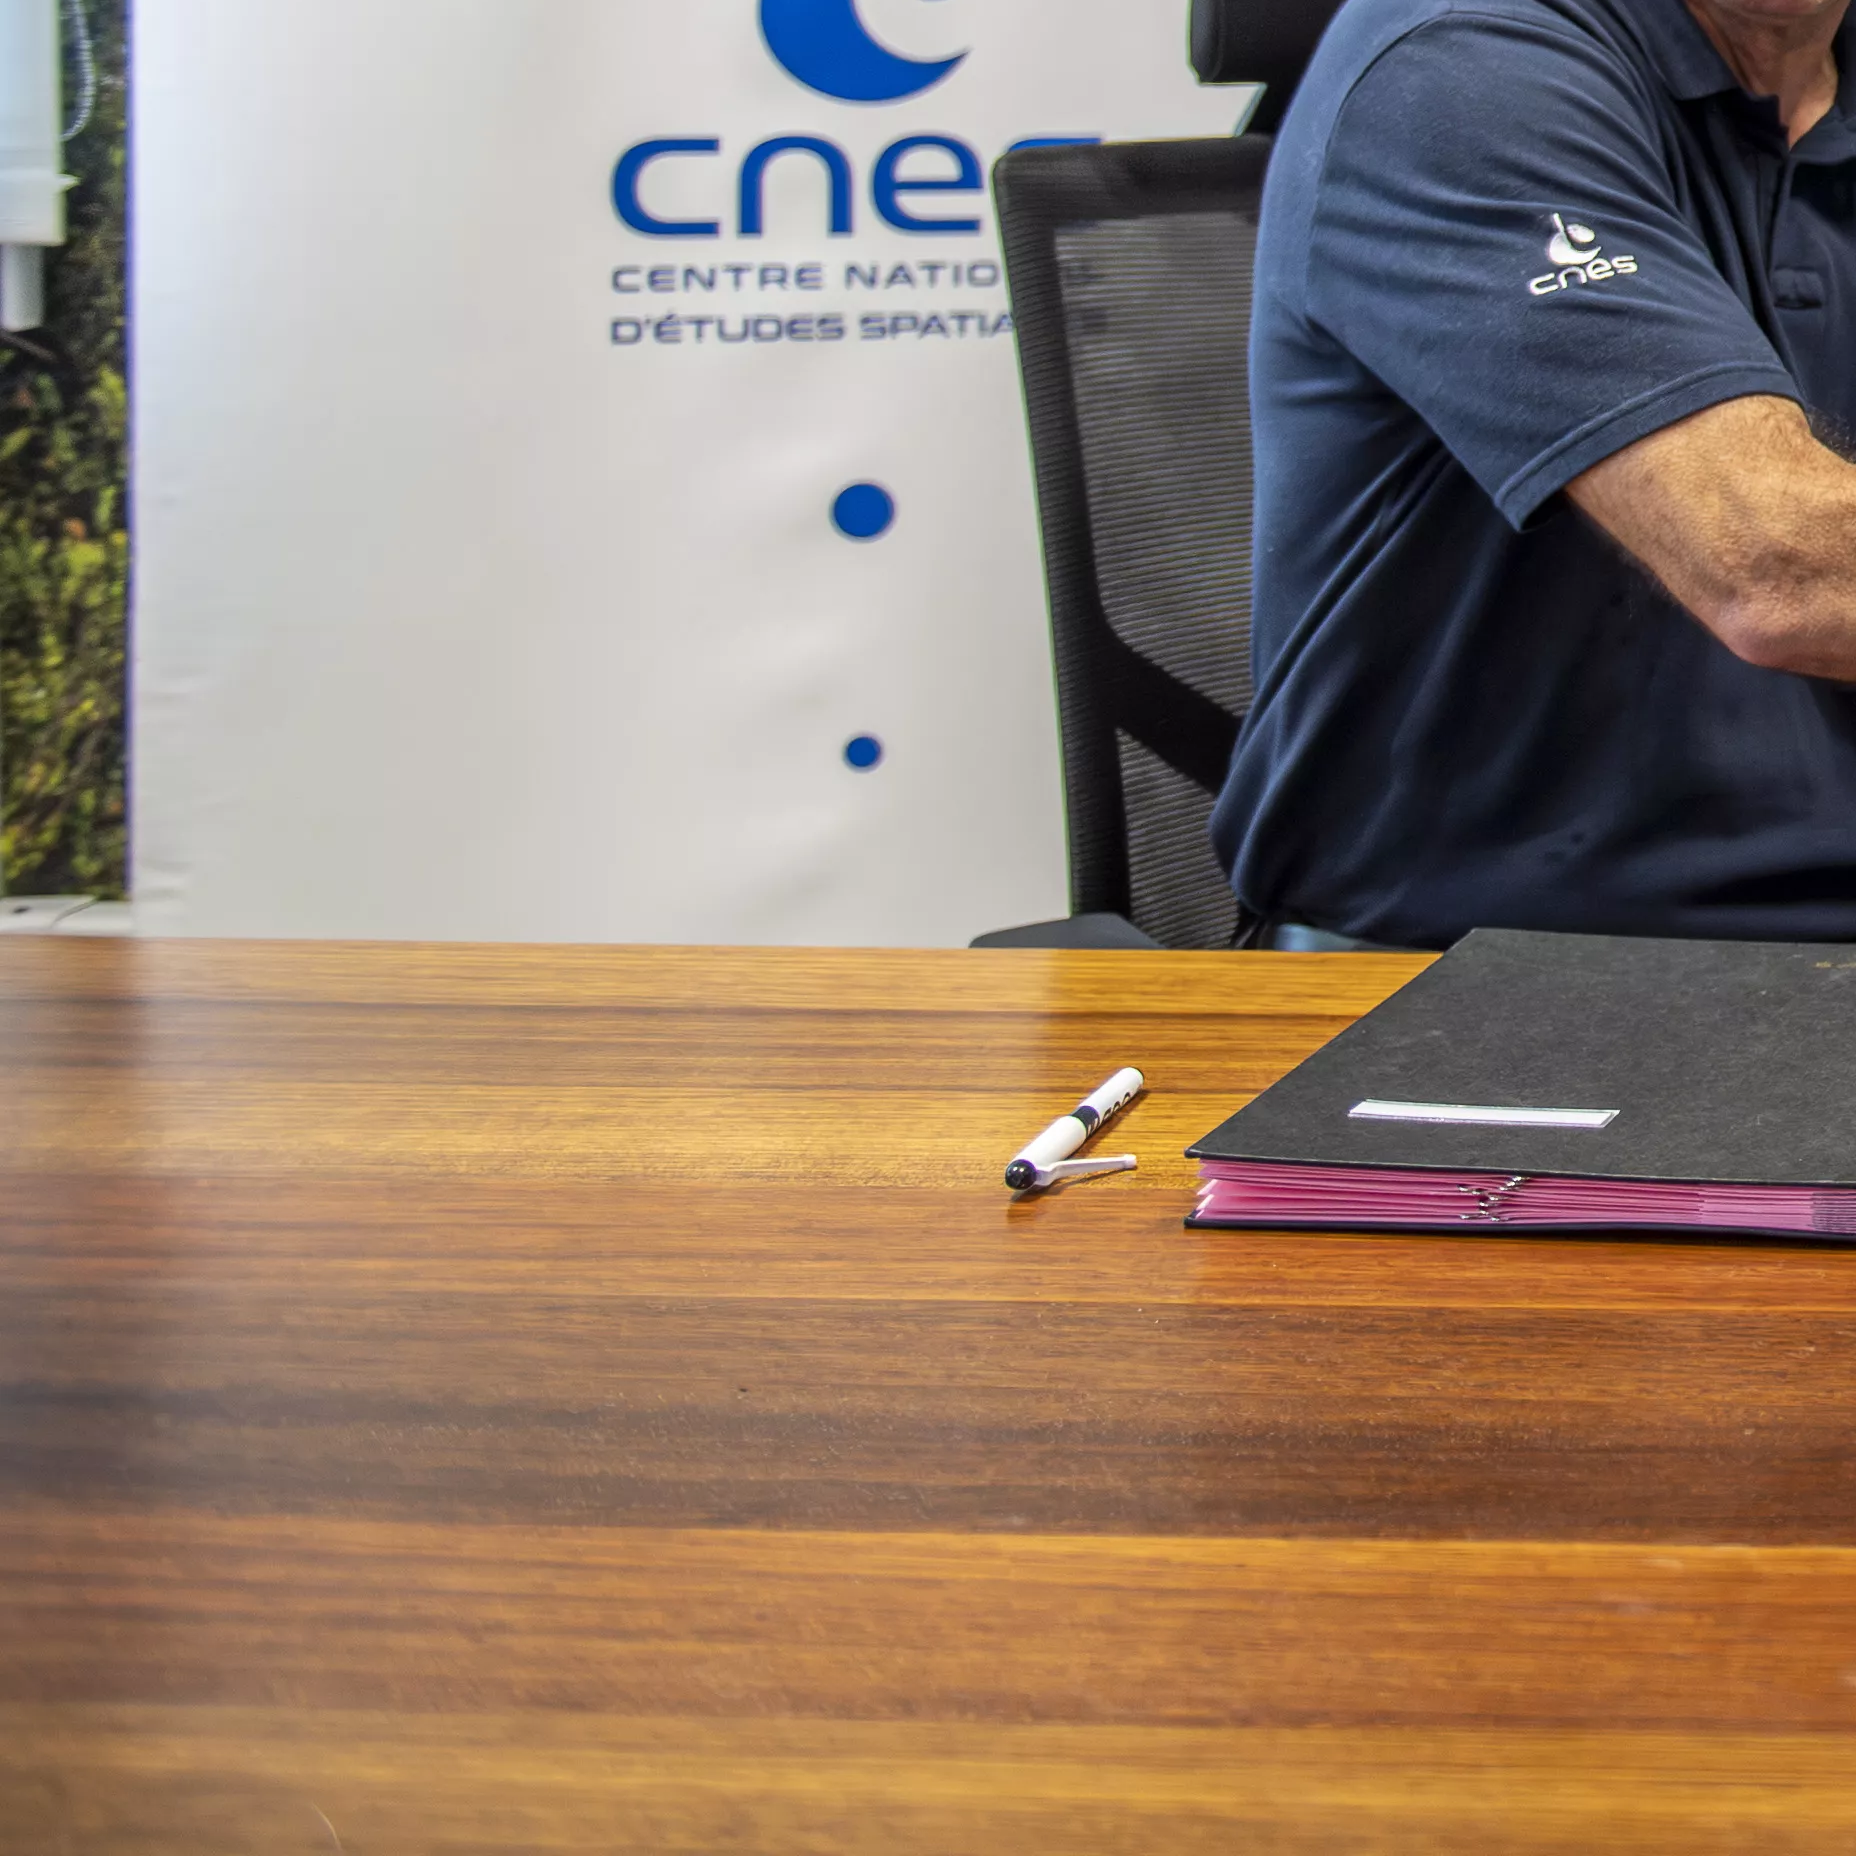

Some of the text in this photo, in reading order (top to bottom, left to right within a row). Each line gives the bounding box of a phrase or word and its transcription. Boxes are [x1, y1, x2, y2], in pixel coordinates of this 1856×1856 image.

[609, 132, 1103, 238] cne
[610, 258, 999, 294] CENTRE NATIO
[1528, 253, 1639, 297] cnes
[609, 309, 1013, 346] D'ÉTUDES SPATIA
